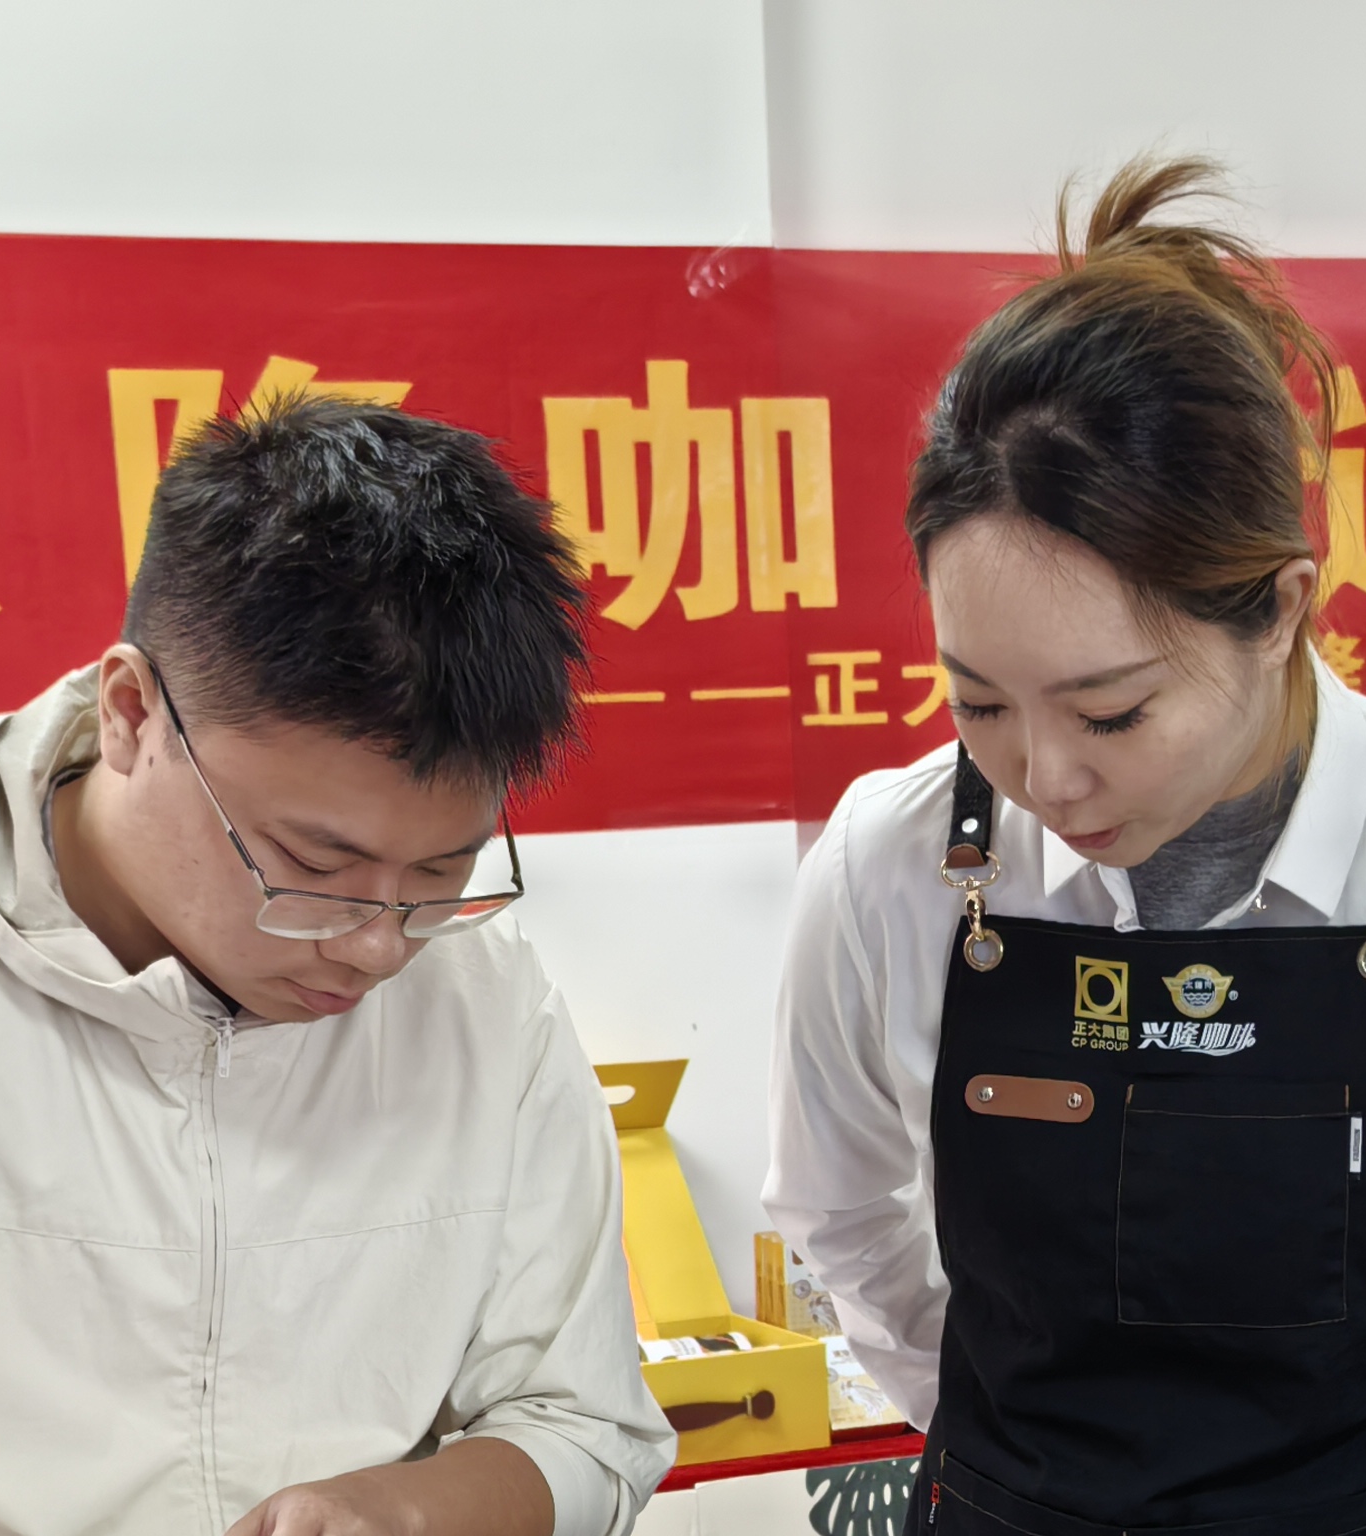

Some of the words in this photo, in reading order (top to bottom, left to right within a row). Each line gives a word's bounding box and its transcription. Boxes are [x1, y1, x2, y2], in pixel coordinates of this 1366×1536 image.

[1071, 1037, 1087, 1048] CP
[1090, 1038, 1129, 1052] GROUP
[1137, 1021, 1257, 1053] 兴隆咖啡
